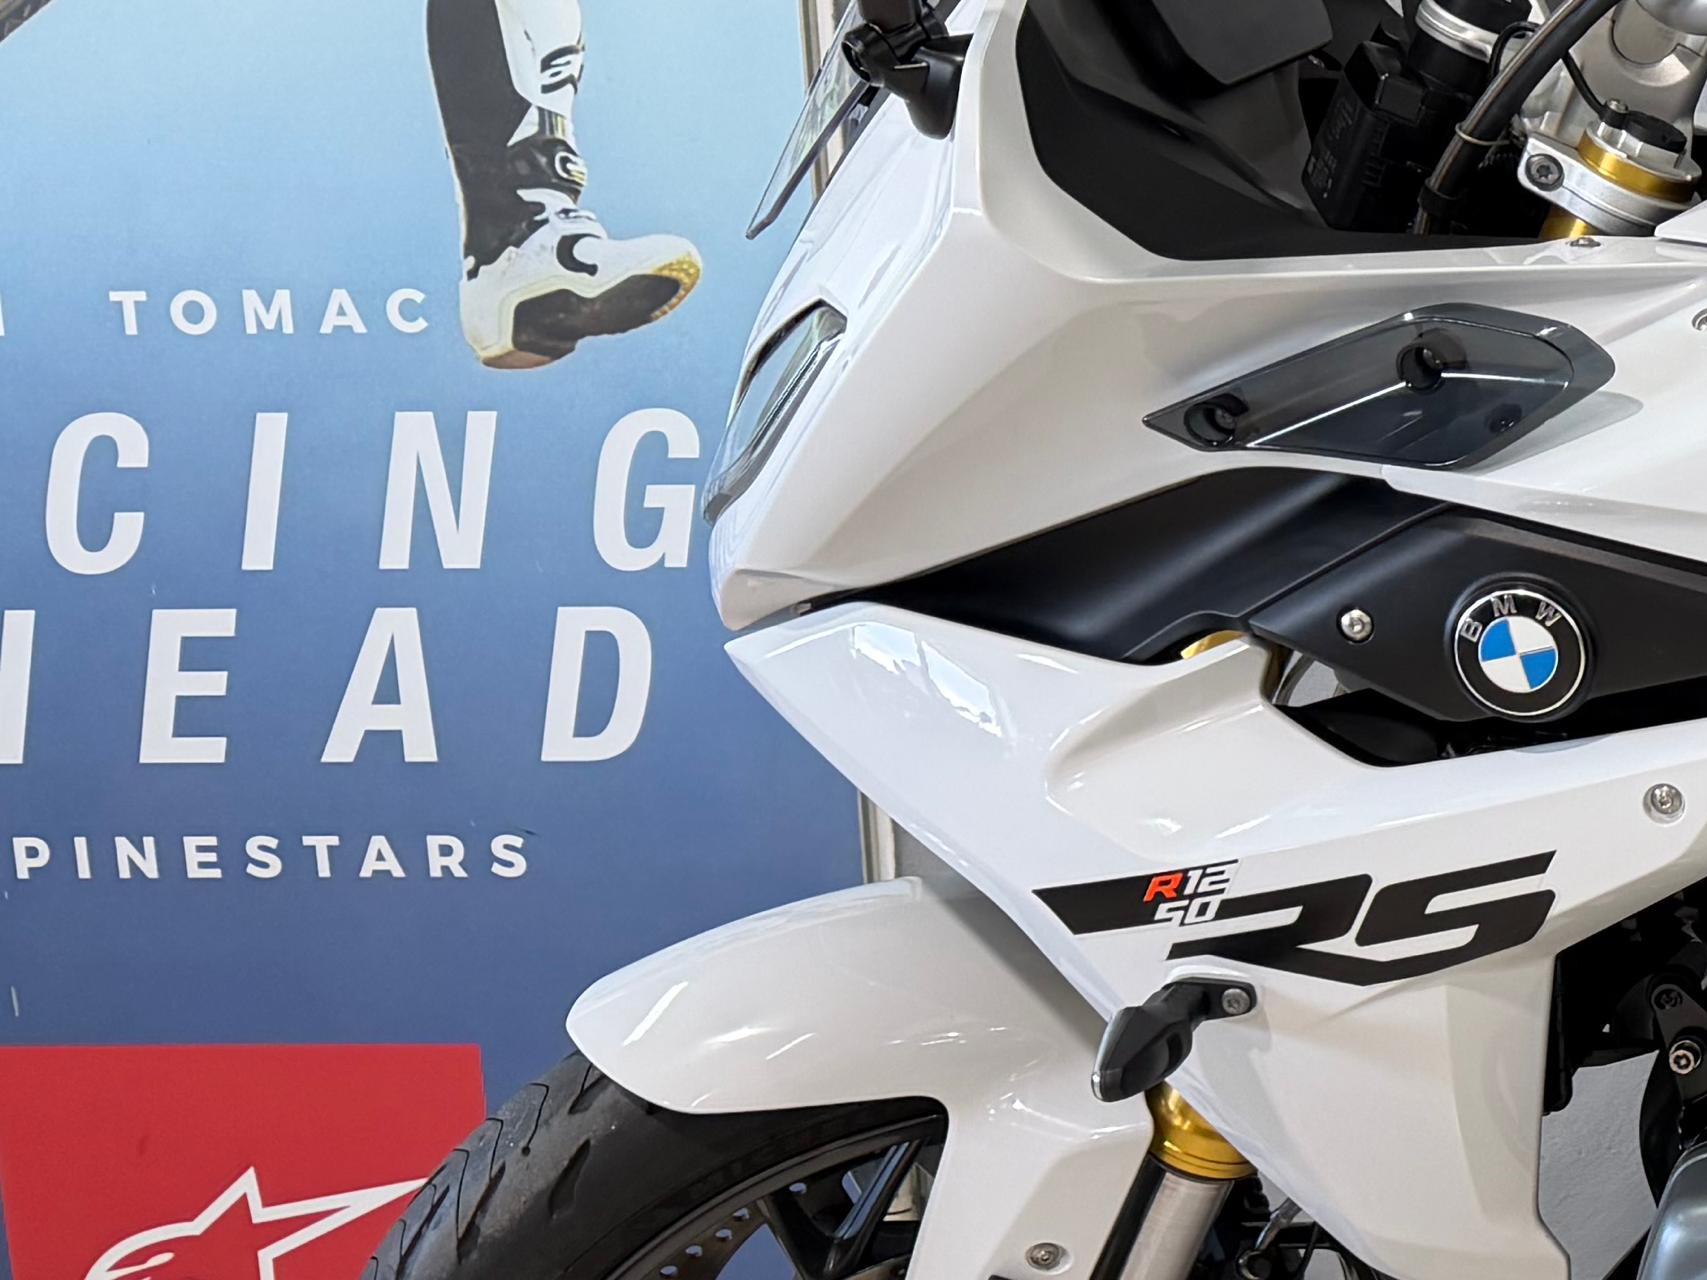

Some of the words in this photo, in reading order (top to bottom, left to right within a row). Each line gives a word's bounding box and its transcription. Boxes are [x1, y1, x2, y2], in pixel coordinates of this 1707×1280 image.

[109, 288, 430, 336] TOMAC
[1460, 594, 1562, 642] BMW
[1166, 850, 1557, 986] RS
